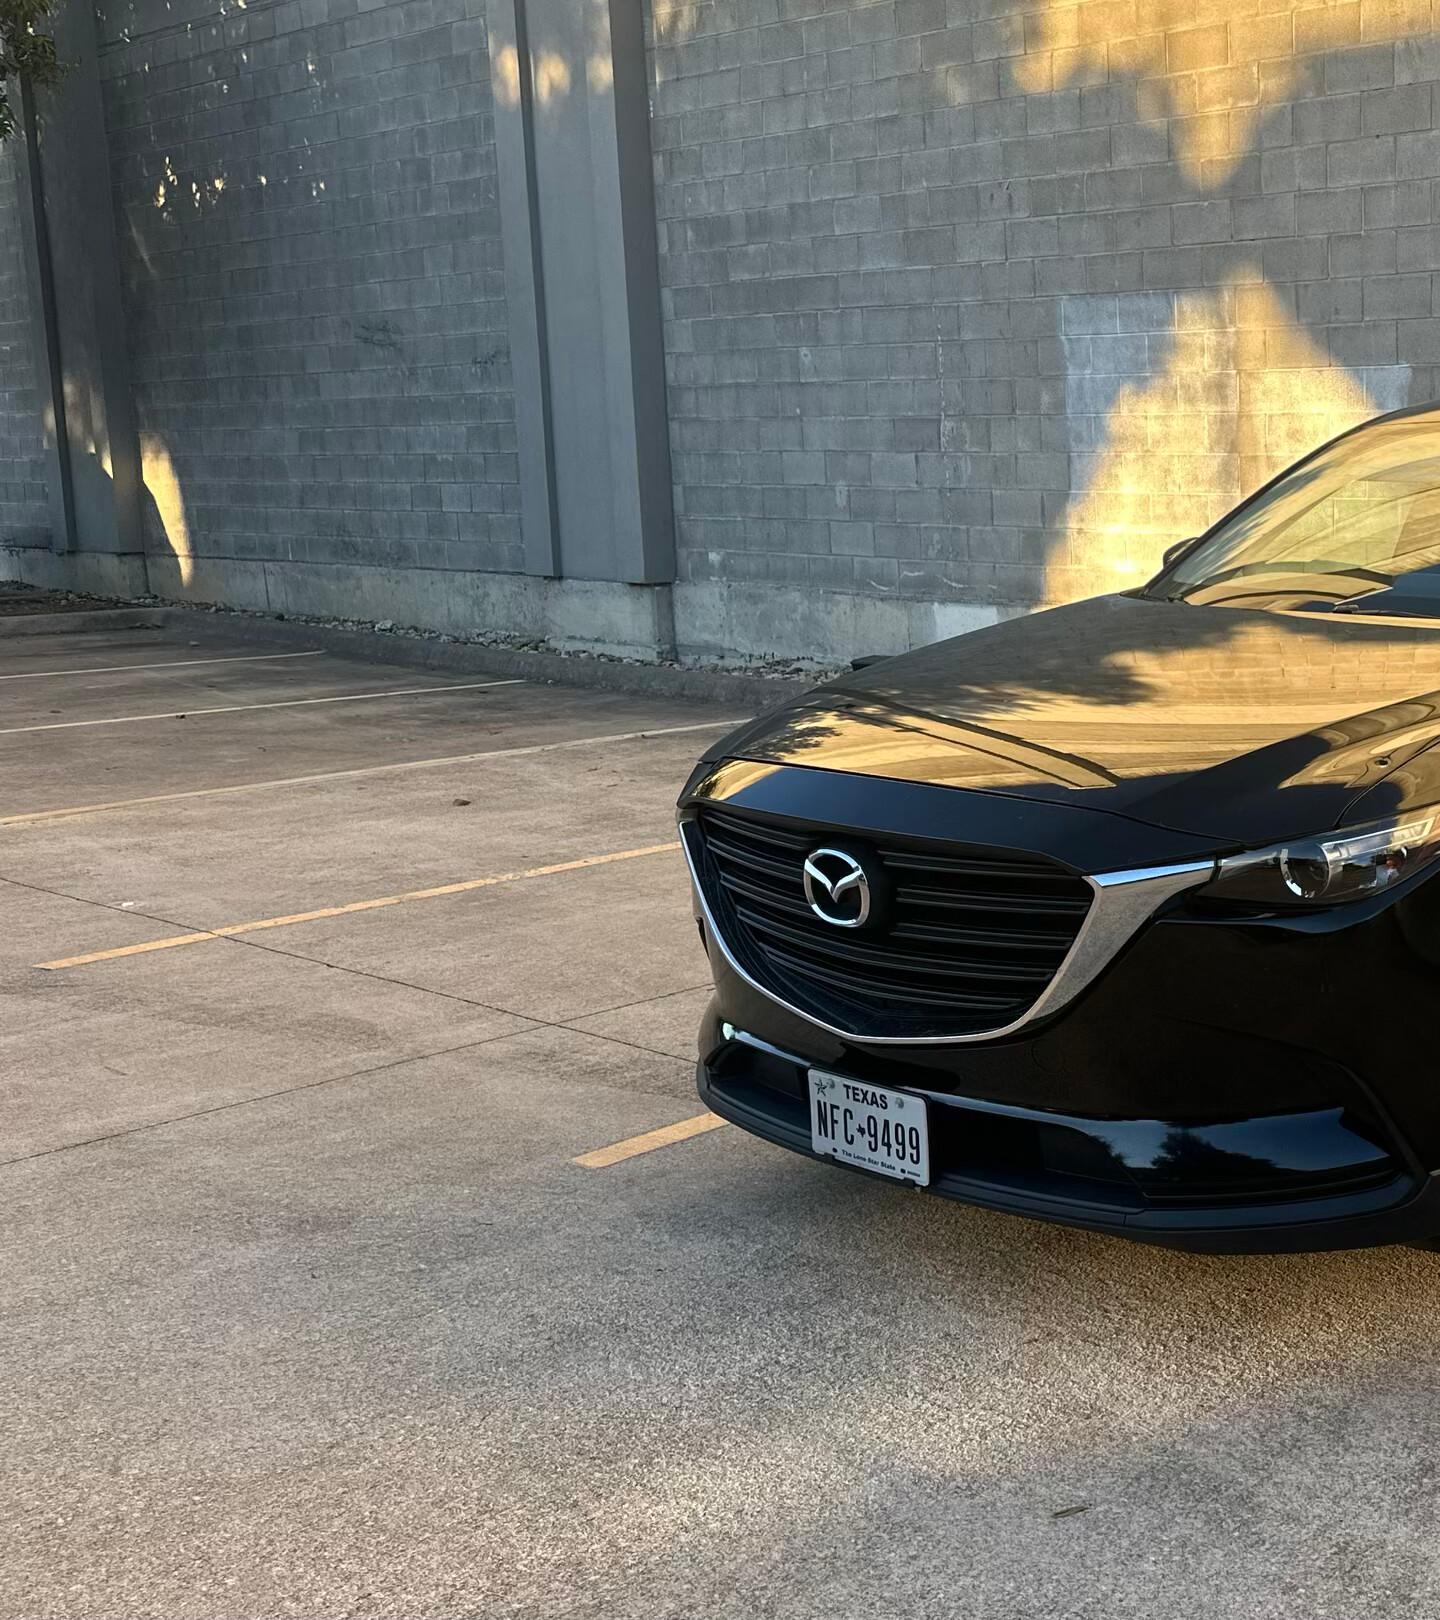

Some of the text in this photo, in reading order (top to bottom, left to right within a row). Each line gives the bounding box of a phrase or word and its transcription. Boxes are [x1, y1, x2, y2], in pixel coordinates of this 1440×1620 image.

[843, 1084, 888, 1110] TEXAS
[842, 1149, 896, 1171] The Lone Star State
